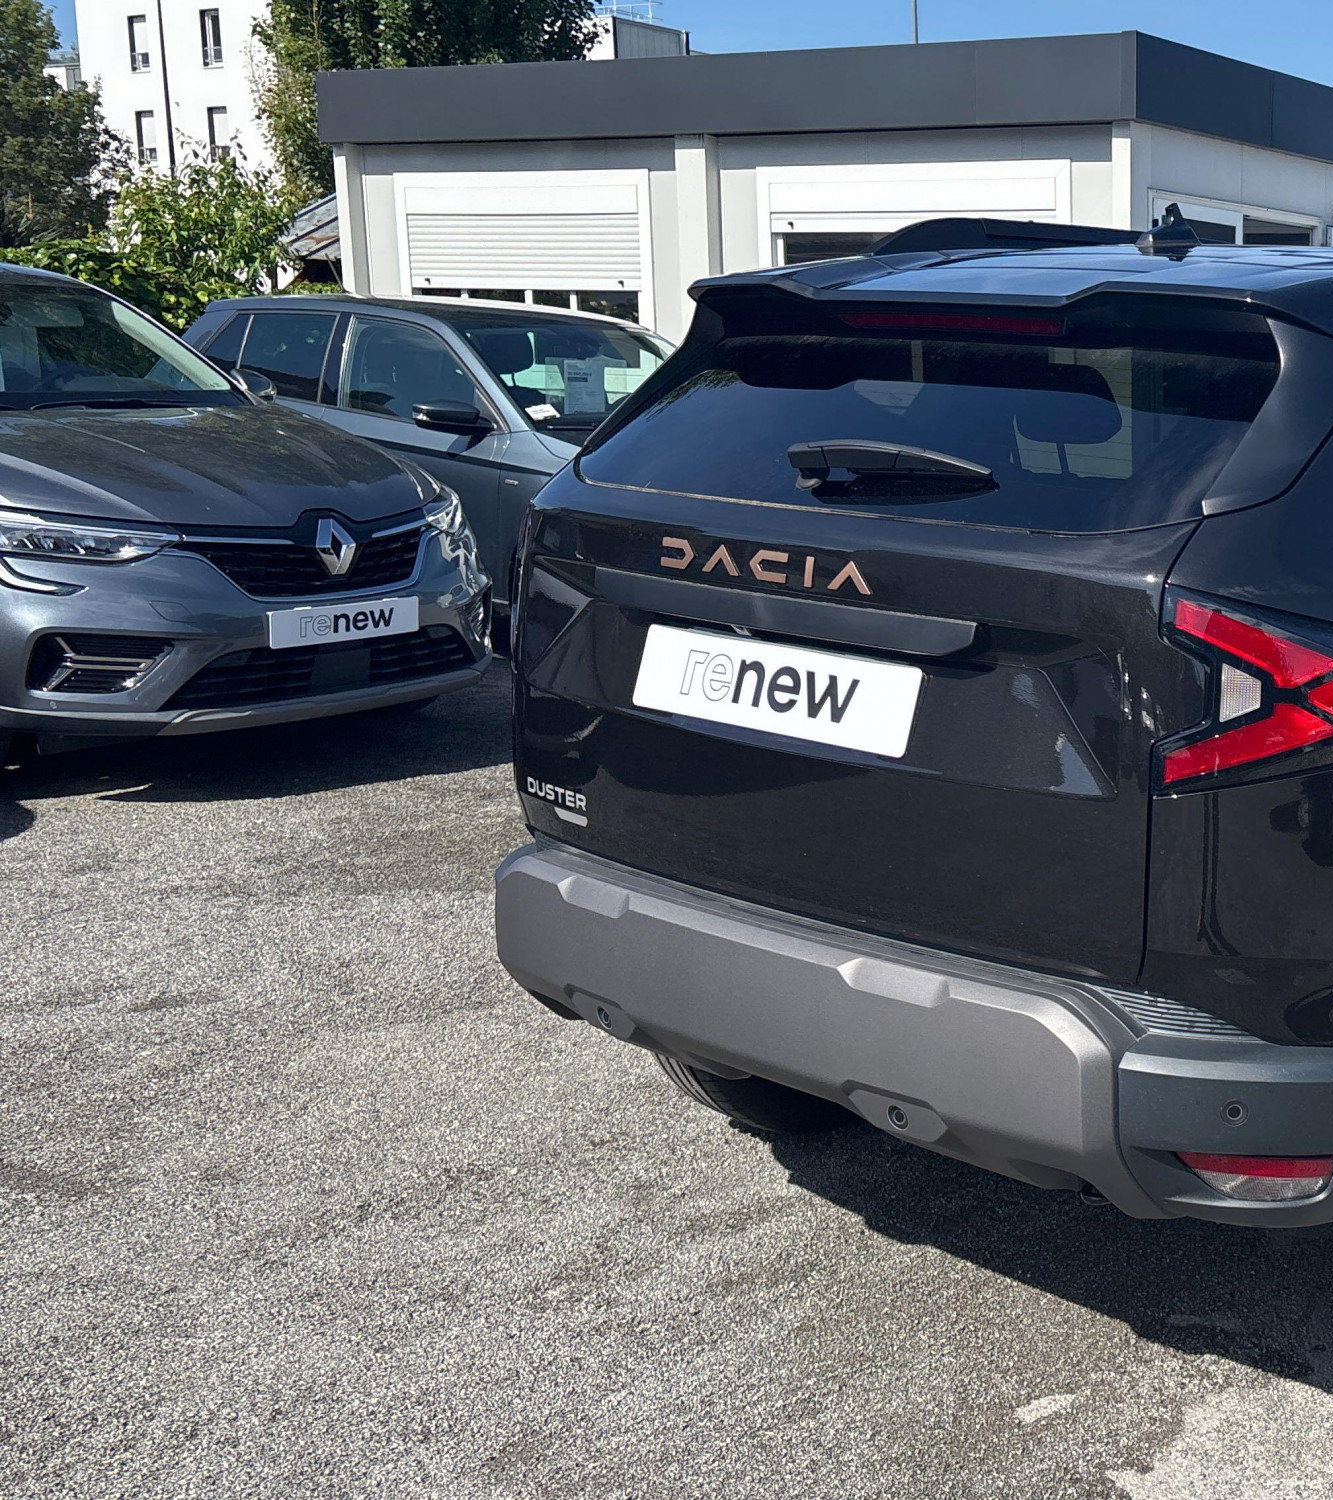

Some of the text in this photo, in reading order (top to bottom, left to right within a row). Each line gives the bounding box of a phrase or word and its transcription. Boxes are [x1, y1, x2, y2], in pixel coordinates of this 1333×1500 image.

[660, 536, 872, 596] DACIA
[299, 607, 394, 638] renew
[680, 649, 861, 724] renew
[527, 775, 587, 812] DUSTER
